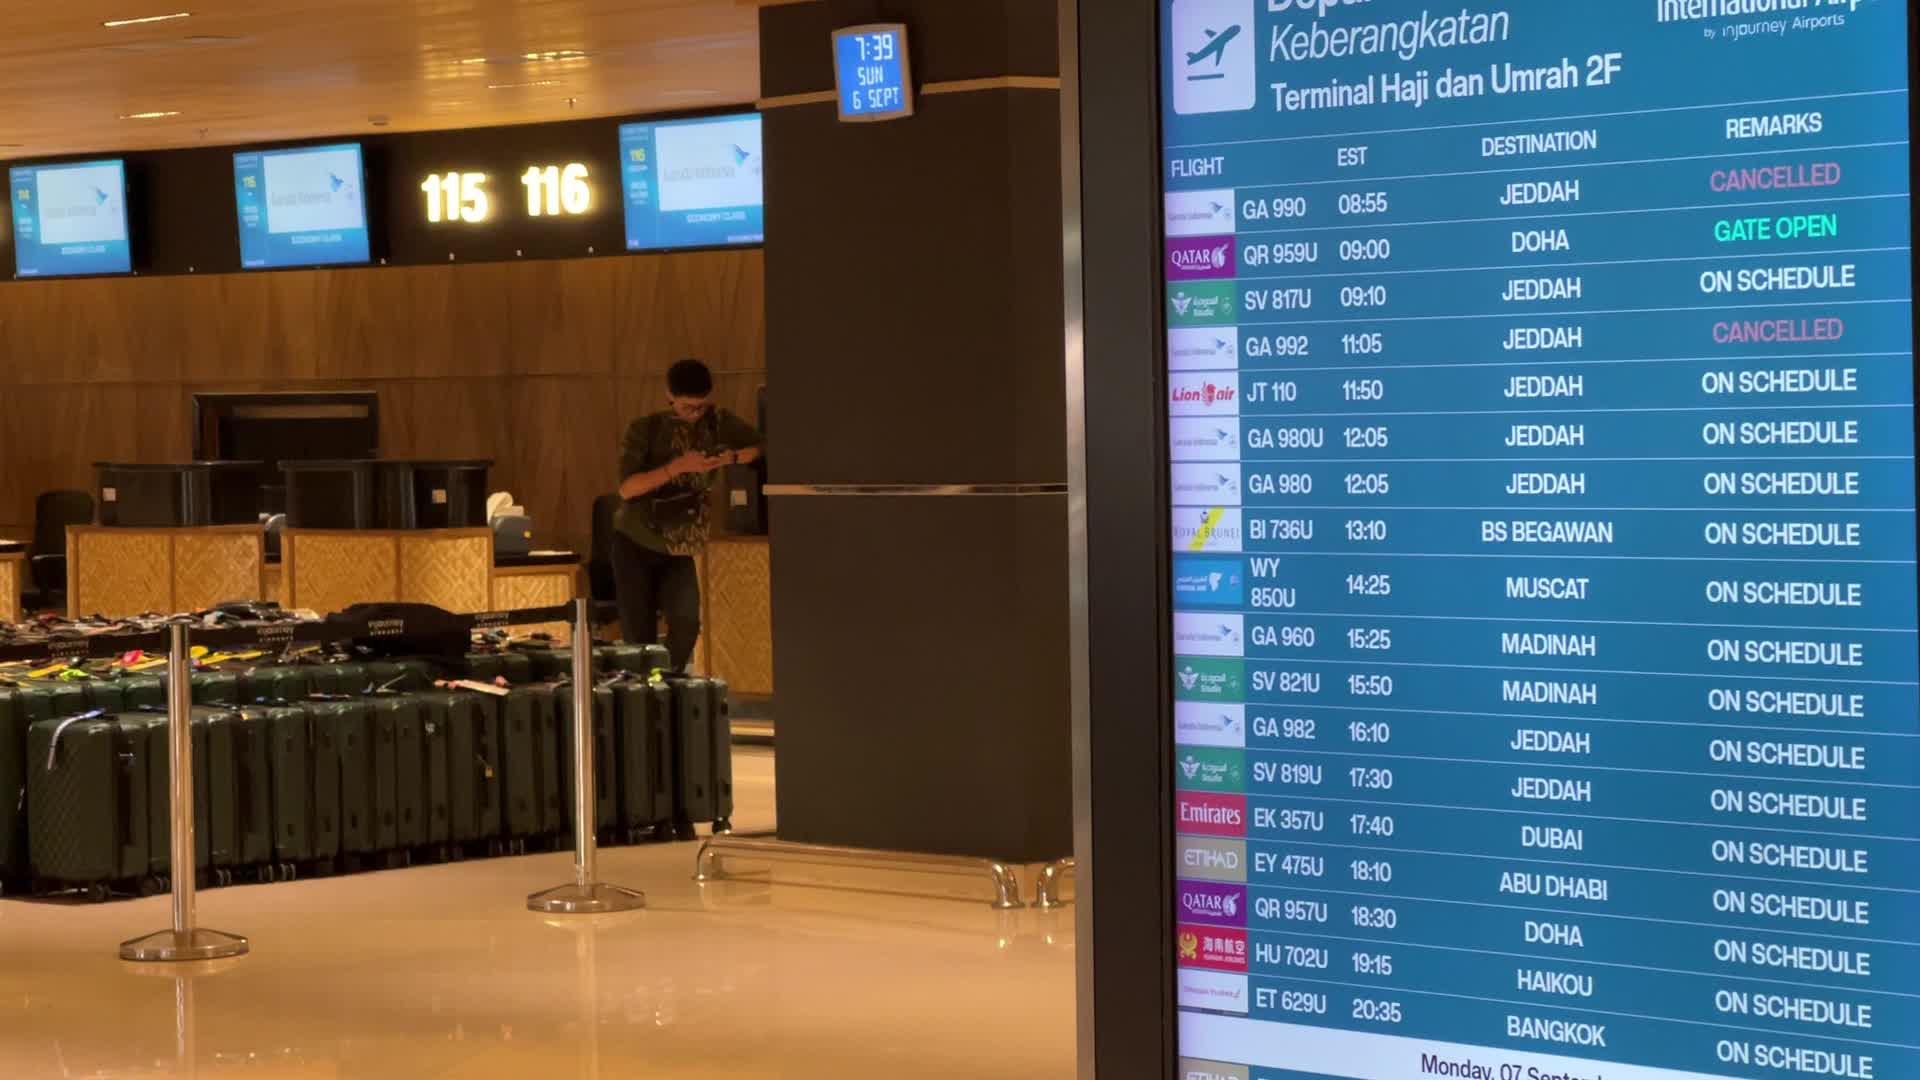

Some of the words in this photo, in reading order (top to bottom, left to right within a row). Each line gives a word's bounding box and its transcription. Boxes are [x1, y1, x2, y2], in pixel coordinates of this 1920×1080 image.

[1658, 0, 1808, 22] Internation
[1270, 11, 1509, 62] Keberangkatan
[1704, 29, 1715, 39] by
[1792, 14, 1845, 30] Airports
[855, 34, 893, 61] 7:39
[857, 65, 883, 86] SUN
[1271, 75, 1374, 111] Terminal
[1381, 70, 1428, 107] Haji
[1436, 68, 1484, 98] dan
[1491, 58, 1578, 93] Umrah
[1586, 52, 1622, 86] 2F
[852, 91, 862, 110] 6
[1726, 112, 1822, 139] REMARKS
[1482, 129, 1597, 156] DESTINATION
[1171, 156, 1225, 177] FLIGHT
[1338, 146, 1368, 166] EST
[1711, 162, 1840, 192] CANCELLED
[421, 172, 489, 223] 115
[521, 163, 591, 217] 116
[1500, 180, 1579, 205] JEDDAH
[1243, 199, 1269, 220] GA
[1273, 197, 1306, 218] 990
[1339, 192, 1387, 214] 08:55
[1715, 218, 1771, 241] GATE
[1776, 214, 1837, 238] OPEN
[1340, 239, 1390, 260] 09:00
[1512, 229, 1570, 252] DOHA
[1171, 249, 1211, 266] QATAR
[1244, 245, 1269, 266] QR
[1273, 242, 1317, 263] 959U
[1502, 277, 1581, 301] JEDDAH
[1700, 270, 1732, 293] ON
[1737, 264, 1855, 291] SCHEDULE
[1245, 290, 1268, 310] SV
[1272, 289, 1311, 309] 817U
[1341, 286, 1386, 307] 09:10
[1503, 327, 1582, 349] JEDDAH
[1713, 318, 1844, 343] CANCELLED
[1246, 336, 1272, 356] GA
[1276, 336, 1308, 355] 992
[1342, 333, 1382, 354] 11:05
[1343, 380, 1383, 400] 11:50
[1504, 375, 1583, 397] JEDDAH
[1702, 372, 1734, 393] ON
[1739, 368, 1857, 393] SCHEDULE
[1172, 385, 1200, 402] Lion
[1216, 386, 1235, 401] air
[1247, 382, 1268, 402] JT
[1272, 382, 1296, 401] 110
[1248, 429, 1274, 448] GA
[1278, 428, 1323, 448] 980U
[1344, 427, 1388, 447] 12:05
[1505, 425, 1584, 446] JEDDAH
[1703, 423, 1735, 444] ON
[1740, 421, 1858, 444] SCHEDULE
[1249, 474, 1275, 493] GA
[1279, 474, 1312, 494] 980
[1344, 474, 1389, 494] 12:05
[1506, 473, 1585, 494] JEDDAH
[1704, 472, 1736, 494] ON
[1741, 472, 1859, 494] SCHEDULE
[1250, 519, 1266, 539] BI
[1270, 520, 1312, 539] 736U
[1345, 520, 1386, 540] 13:10
[1482, 521, 1507, 542] BS
[1512, 521, 1613, 543] BEGAWAN
[1705, 522, 1737, 544] ON
[1742, 523, 1860, 545] SCHEDULE
[1250, 558, 1280, 578] WY
[1346, 574, 1390, 595] 14:25
[1506, 577, 1589, 599] MUSCAT
[1706, 581, 1738, 603] ON
[1744, 582, 1861, 606] SCHEDULE
[1251, 587, 1295, 607] 850U
[1252, 626, 1278, 645] GA
[1281, 627, 1315, 647] 960
[1347, 628, 1391, 649] 15:25
[1502, 633, 1596, 656] MADINAH
[1707, 640, 1739, 661] ON
[1744, 640, 1863, 666] SCHEDULE
[1253, 671, 1276, 691] SV
[1280, 672, 1320, 693] 821U
[1348, 674, 1392, 696] 15:50
[1503, 680, 1596, 704] MADINAH
[1708, 689, 1740, 711] ON
[1746, 690, 1864, 717] SCHEDULE
[1253, 717, 1279, 737] GA
[1283, 718, 1315, 739] 982
[1348, 721, 1390, 742] 16:10
[1510, 729, 1590, 753] JEDDAH
[1709, 740, 1742, 762] ON
[1747, 742, 1865, 769] SCHEDULE
[1253, 762, 1277, 782] SV
[1281, 763, 1321, 784] 819U
[1349, 768, 1392, 789] 17:30
[1511, 777, 1591, 802] JEDDAH
[1180, 803, 1241, 825] Emirates
[1711, 789, 1743, 812] ON
[1748, 792, 1866, 820] SCHEDULE
[1255, 808, 1276, 828] EK
[1280, 810, 1323, 831] 357U
[1350, 814, 1393, 836] 17:40
[1522, 826, 1583, 850] DUBAI
[1184, 849, 1239, 870] ETIHAD
[1255, 853, 1277, 872] EY
[1282, 855, 1323, 876] 475U
[1712, 840, 1744, 863] ON
[1749, 843, 1868, 872] SCHEDULE
[1350, 860, 1391, 882] 18:10
[1500, 872, 1540, 894] ABU
[1545, 875, 1608, 900] DHABI
[1183, 892, 1222, 911] QATAR
[1255, 897, 1280, 919] QR
[1284, 900, 1327, 922] 957U
[1713, 889, 1745, 912] ON
[1750, 893, 1869, 924] SCHEDULE
[1352, 906, 1396, 928] 18:30
[1525, 921, 1584, 947] DOHA
[1256, 943, 1281, 964] HU
[1285, 946, 1328, 968] 702U
[1352, 953, 1392, 975] 19:15
[1714, 939, 1746, 963] ON
[1752, 943, 1870, 975] SCHEDULE
[1517, 969, 1592, 996] HAIKOU
[1256, 988, 1277, 1008] ET
[1282, 991, 1326, 1014] 629U
[1353, 999, 1402, 1022] 20:35
[1715, 990, 1748, 1014] ON
[1753, 994, 1872, 1028] SCHEDULE
[1507, 1015, 1606, 1047] BANGKOK
[1717, 1040, 1749, 1064] ON
[1754, 1044, 1873, 1079] SCHEDULE
[1500, 1063, 1521, 1080] 07
